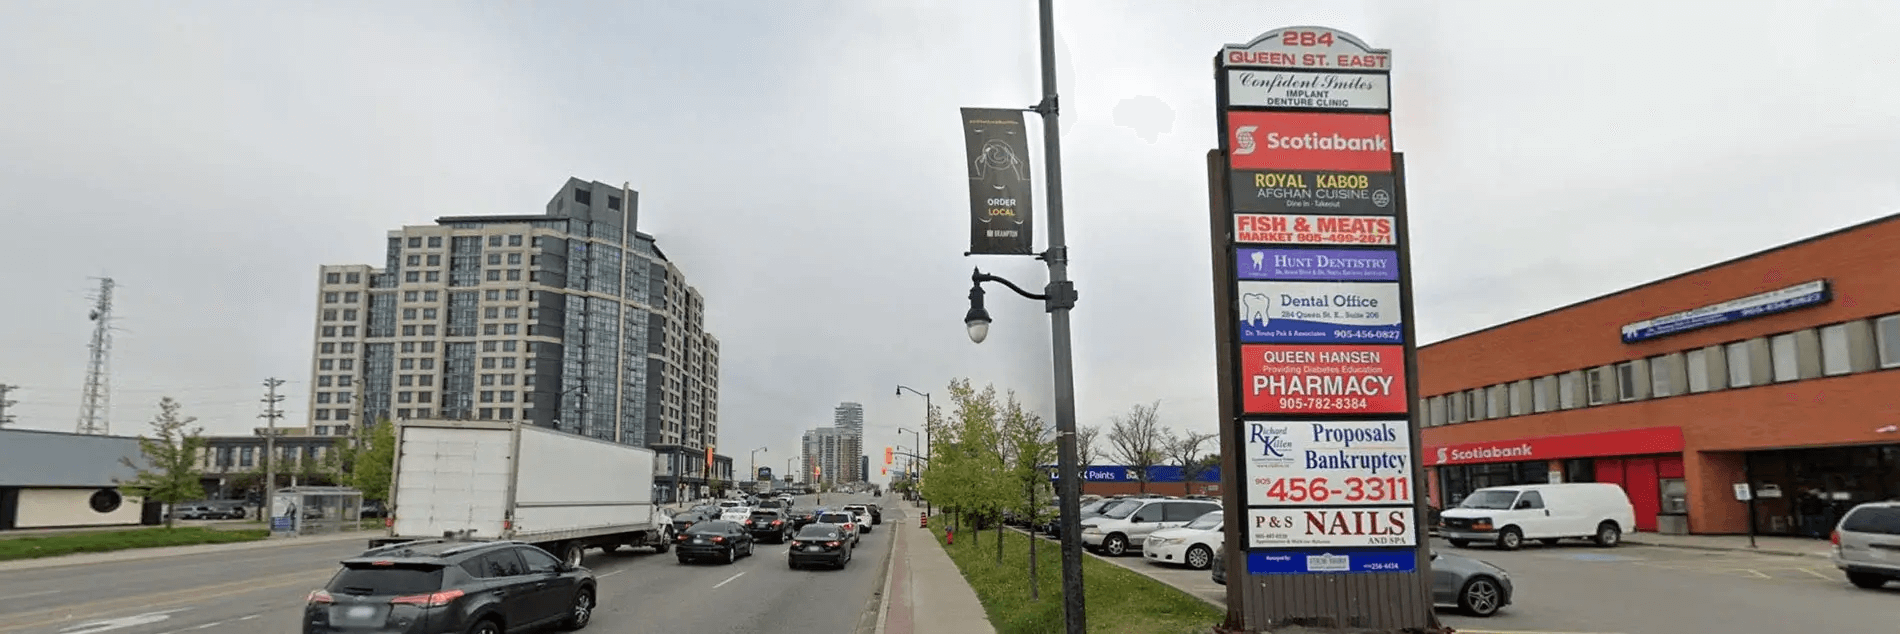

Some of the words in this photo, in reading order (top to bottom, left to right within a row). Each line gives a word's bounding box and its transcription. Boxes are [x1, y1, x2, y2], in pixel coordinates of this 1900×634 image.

[1282, 31, 1334, 47] 284
[1229, 51, 1296, 65] QUEEN
[1303, 53, 1330, 66] ST.
[1337, 55, 1387, 68] EAST
[1239, 72, 1319, 93] Confident
[1321, 74, 1373, 91] Smiles
[1286, 90, 1329, 98] IMPLANT
[1267, 98, 1313, 106] DENTURE
[1316, 99, 1349, 107] CLINIC
[1267, 132, 1387, 152] Scotiabank
[1255, 173, 1307, 188] ROYAL
[1316, 174, 1368, 189] KABOB
[1257, 188, 1312, 198] AFGHAN
[1316, 189, 1369, 200] CUISINE
[987, 198, 1016, 206] ORDER
[989, 208, 1016, 216] LOCAL
[1237, 216, 1287, 232] FISH
[1293, 217, 1311, 232] &
[1317, 217, 1390, 234] MEATS
[1239, 232, 1292, 241] MARKET
[1281, 294, 1329, 307] Dental
[1333, 295, 1378, 308] Office
[1296, 311, 1321, 319] Queen
[1334, 329, 1400, 340] 905-456-0827
[1264, 351, 1315, 363] QUEEN
[1320, 351, 1380, 363] HANSEN
[1263, 365, 1301, 373] Providing
[1253, 375, 1393, 396] PHARMACY
[1279, 398, 1367, 409] 905-782-8384
[1250, 423, 1288, 443] Richard
[1312, 423, 1396, 447] Proposals
[1263, 436, 1293, 457] Killen
[1451, 444, 1532, 460] Scotiabank
[1305, 450, 1407, 474] Bankruptcy
[1089, 470, 1115, 479] Paints
[1266, 477, 1409, 501] 456-3311
[1256, 516, 1265, 528] P
[1269, 516, 1281, 528] &
[1285, 516, 1293, 528] S
[1304, 511, 1406, 535] NAILS
[1367, 537, 1387, 545] AND
[1389, 537, 1406, 545] SPA
